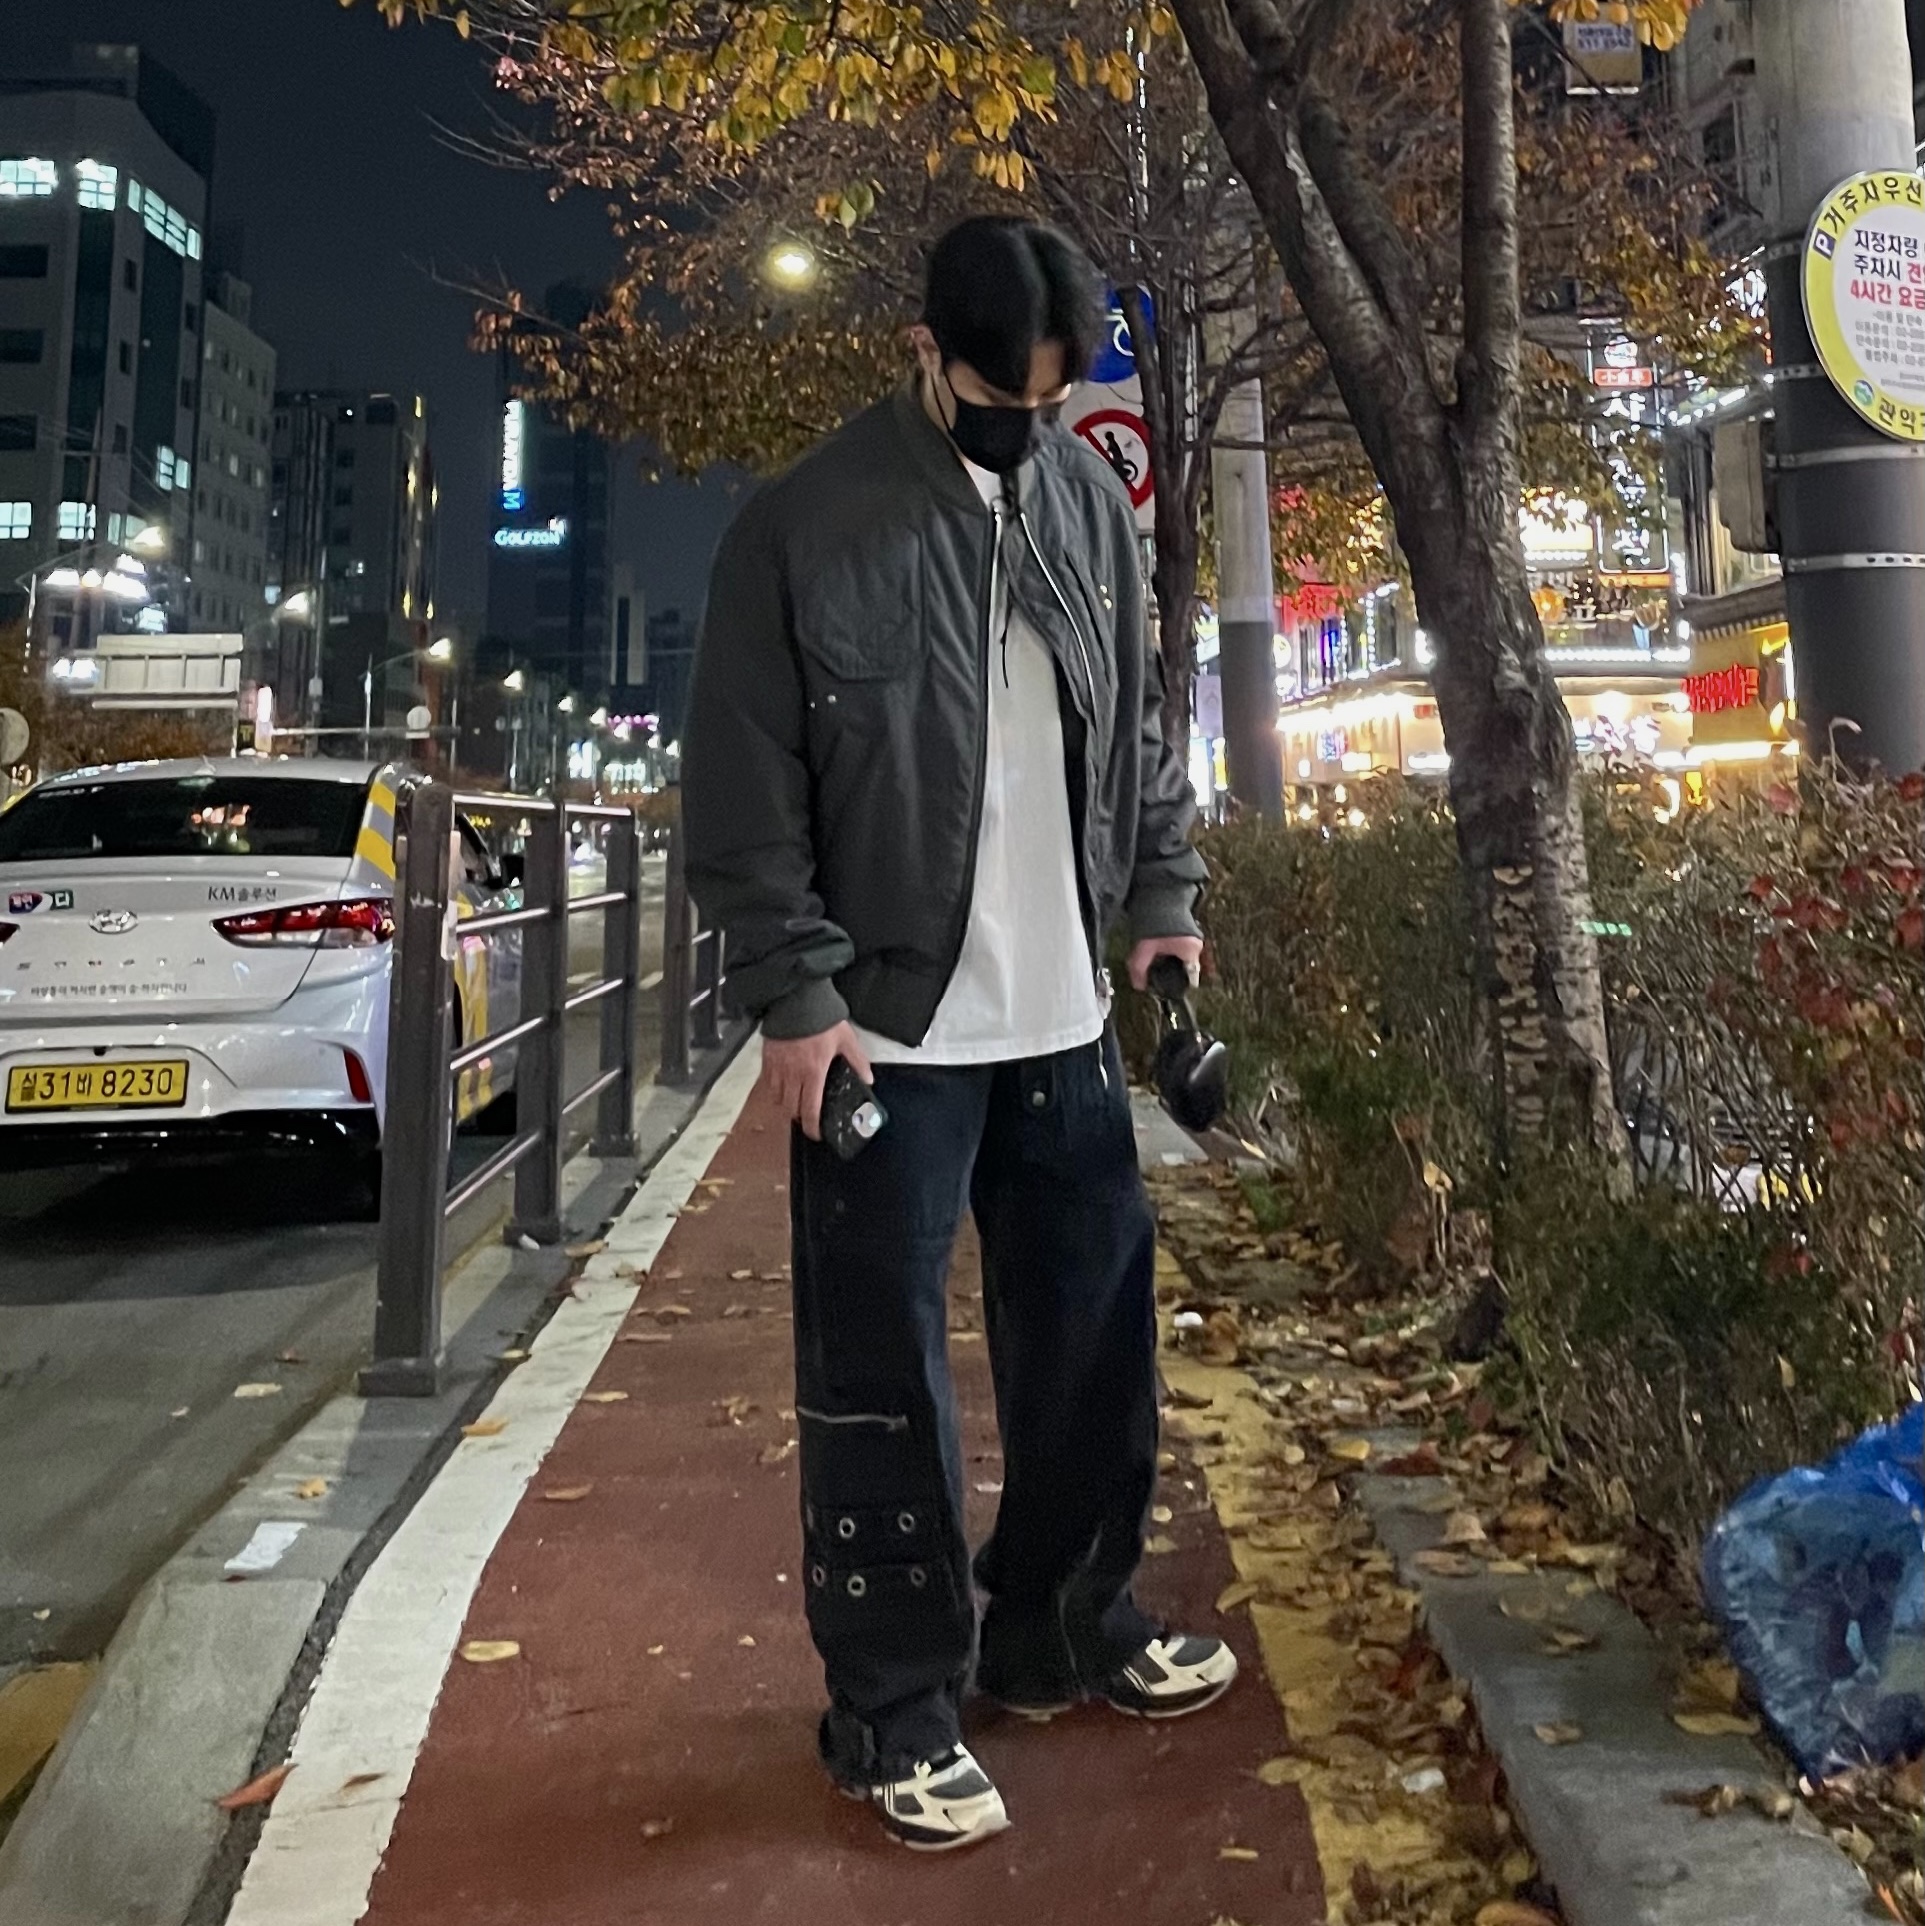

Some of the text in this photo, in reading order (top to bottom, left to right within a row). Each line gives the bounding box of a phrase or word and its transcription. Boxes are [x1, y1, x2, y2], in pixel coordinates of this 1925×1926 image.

[1854, 229, 1918, 259] 지정차량
[1854, 254, 1925, 284] 주차시 견
[1850, 279, 1892, 305] 4시간
[1878, 396, 1925, 435] 관악
[101, 1067, 173, 1097] 8230
